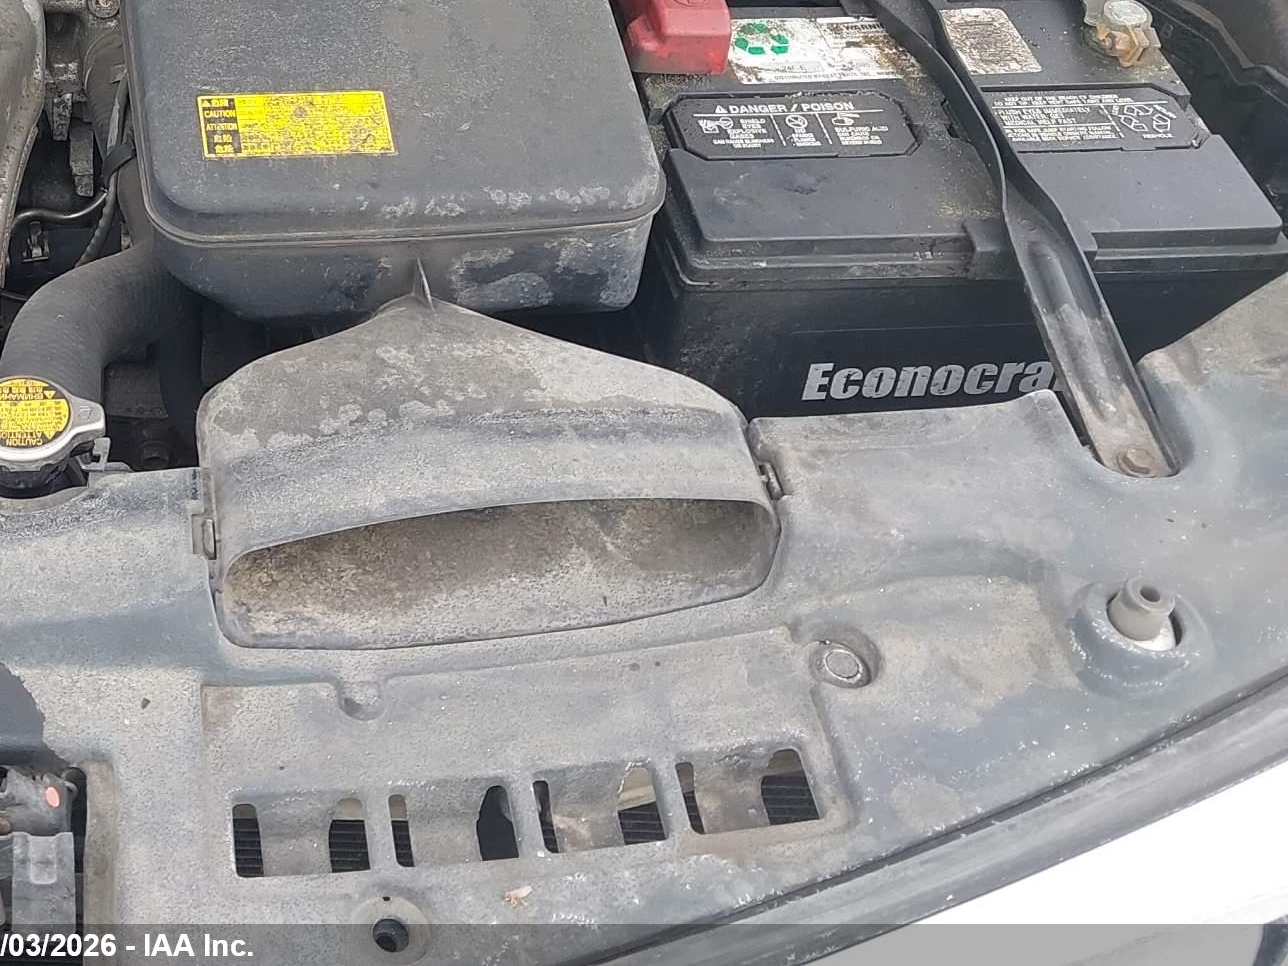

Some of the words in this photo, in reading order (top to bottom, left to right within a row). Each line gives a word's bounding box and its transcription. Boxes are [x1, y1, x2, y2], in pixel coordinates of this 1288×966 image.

[729, 104, 788, 114] DANGER
[802, 101, 855, 112] POISON
[204, 110, 236, 119] CAUTION
[206, 122, 238, 131] ATTENTION
[6, 438, 43, 446] CAUTION
